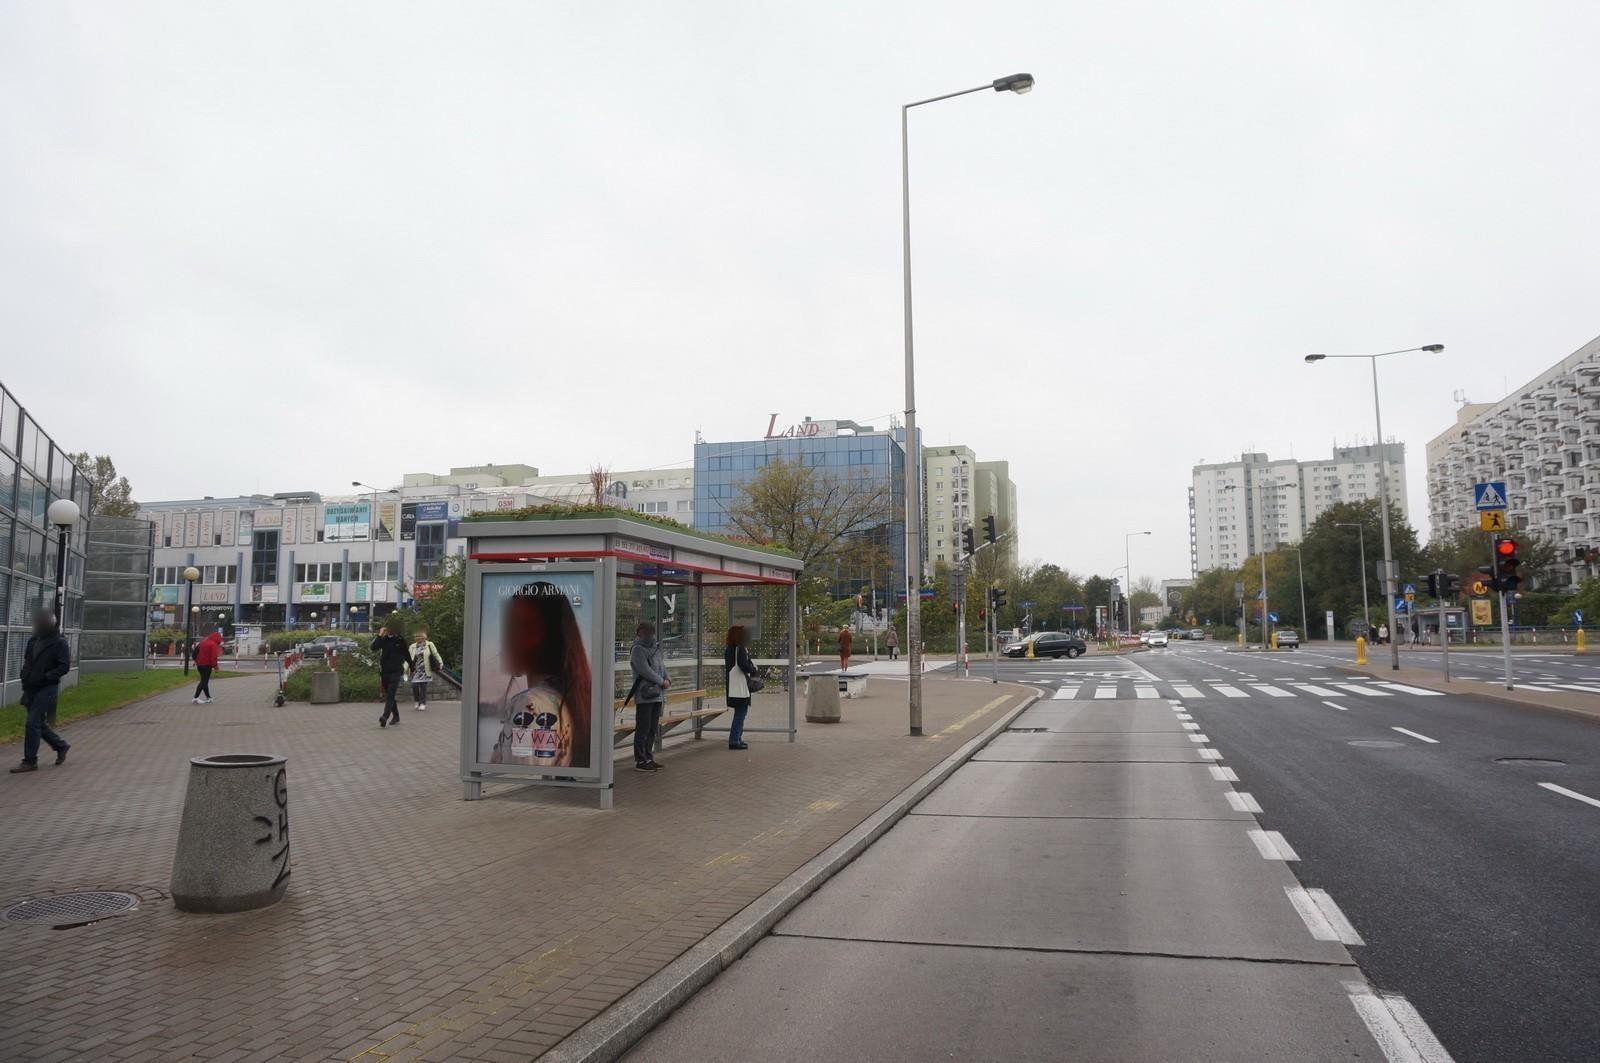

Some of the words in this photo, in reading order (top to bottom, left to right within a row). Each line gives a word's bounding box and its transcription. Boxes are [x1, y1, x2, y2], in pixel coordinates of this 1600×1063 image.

[498, 584, 539, 596] GIORGIO
[541, 583, 580, 596] ARMANI
[503, 732, 525, 745] MY
[531, 732, 566, 745] WAY
